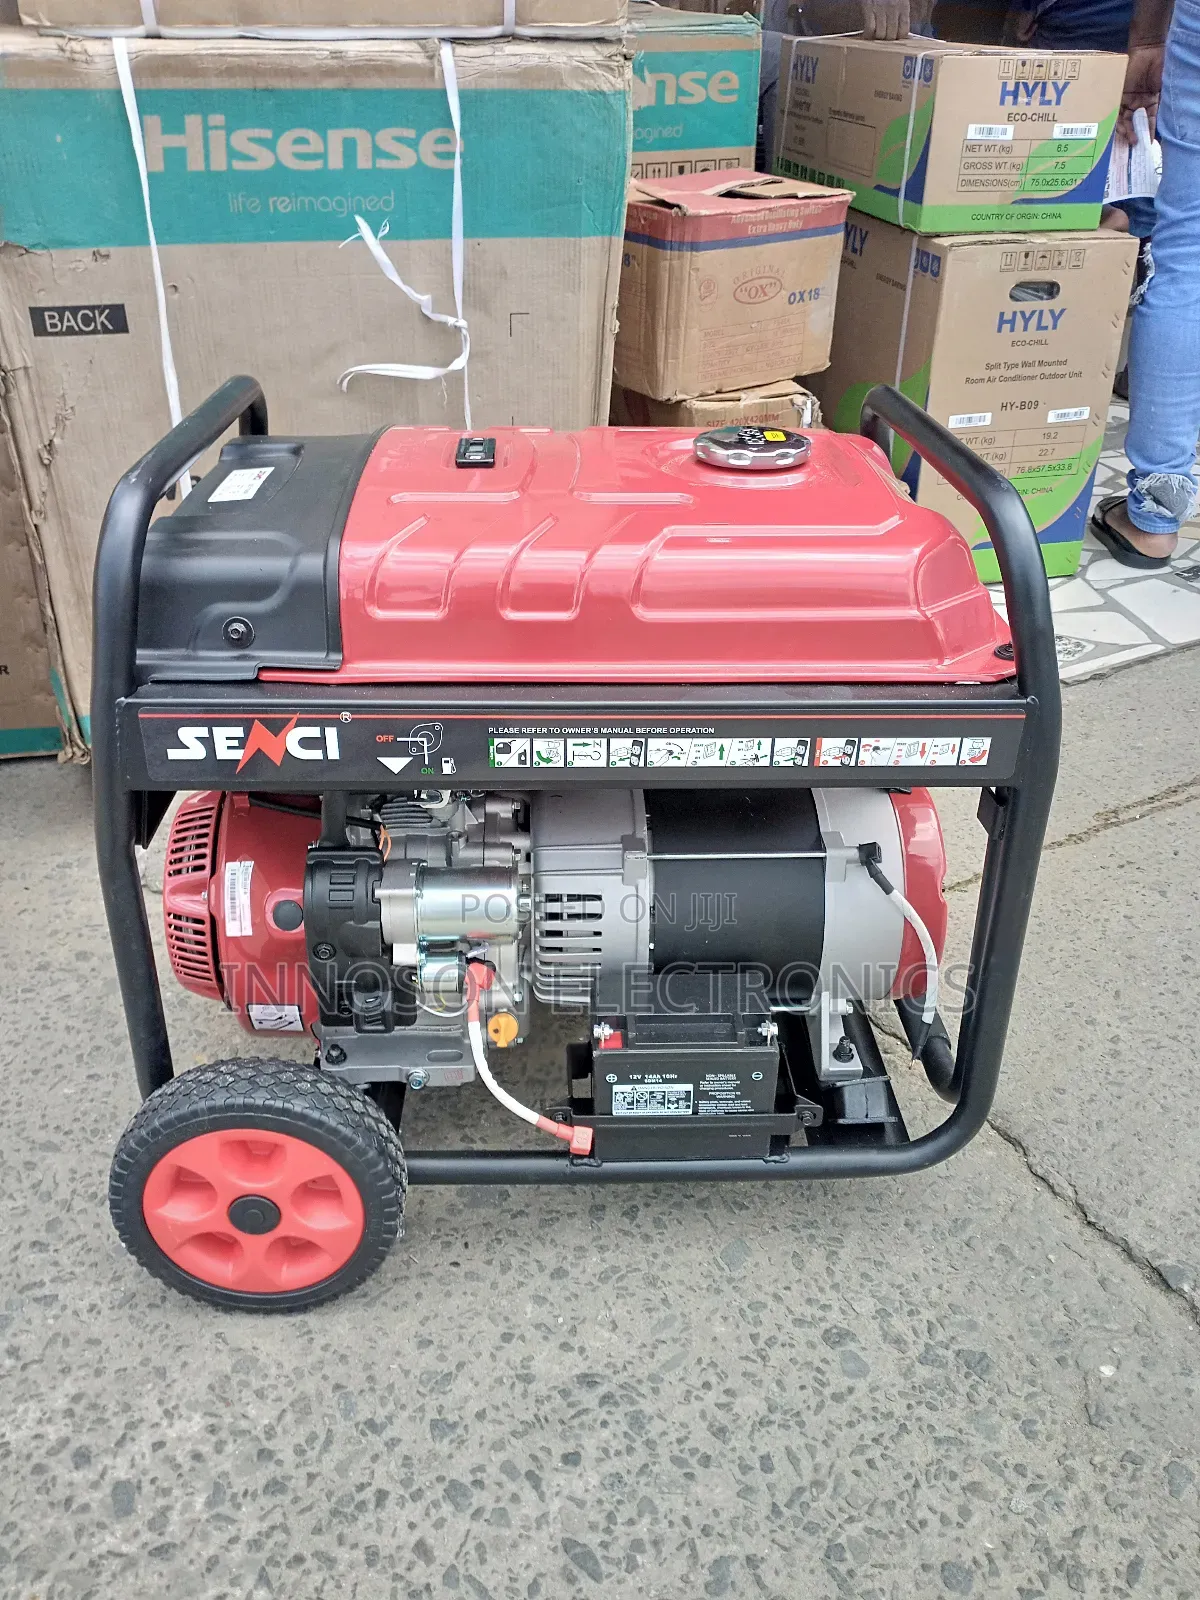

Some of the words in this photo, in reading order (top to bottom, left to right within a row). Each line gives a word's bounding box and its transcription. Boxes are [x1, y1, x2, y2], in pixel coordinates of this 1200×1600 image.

[632, 69, 739, 105] nse
[999, 81, 1071, 107] HYLY
[1007, 112, 1058, 122] ECO-CHILL
[633, 122, 683, 144] agined
[144, 114, 465, 172] Hisense
[965, 144, 982, 153] NET
[963, 161, 993, 170] GROSS
[1054, 161, 1066, 170] 7.5
[960, 179, 1023, 189] DIMENSIONS(cm)
[228, 191, 261, 213] life
[268, 190, 396, 218] reimagined
[971, 213, 1005, 221] COUNTRY
[1040, 212, 1062, 220] CHINA
[748, 224, 767, 234] Extra
[845, 221, 868, 257] YLY
[45, 308, 111, 333] BACK
[997, 308, 1067, 333] HYLY
[1011, 339, 1049, 347] ECO-CHILL
[985, 361, 1002, 371] Split
[1003, 361, 1019, 371] Type
[1021, 360, 1036, 368] Wall
[1037, 358, 1068, 368] Mounted
[986, 375, 996, 383] Air
[998, 374, 1038, 383] Conditioner
[1039, 372, 1067, 380] Outdoor
[1068, 371, 1082, 379] Unit
[1000, 400, 1039, 412] HY-B09
[1042, 431, 1058, 440] 19.2
[1038, 448, 1055, 457] 22.7
[166, 711, 340, 775] SENCI
[376, 735, 394, 743] OFF
[421, 767, 434, 775] ON
